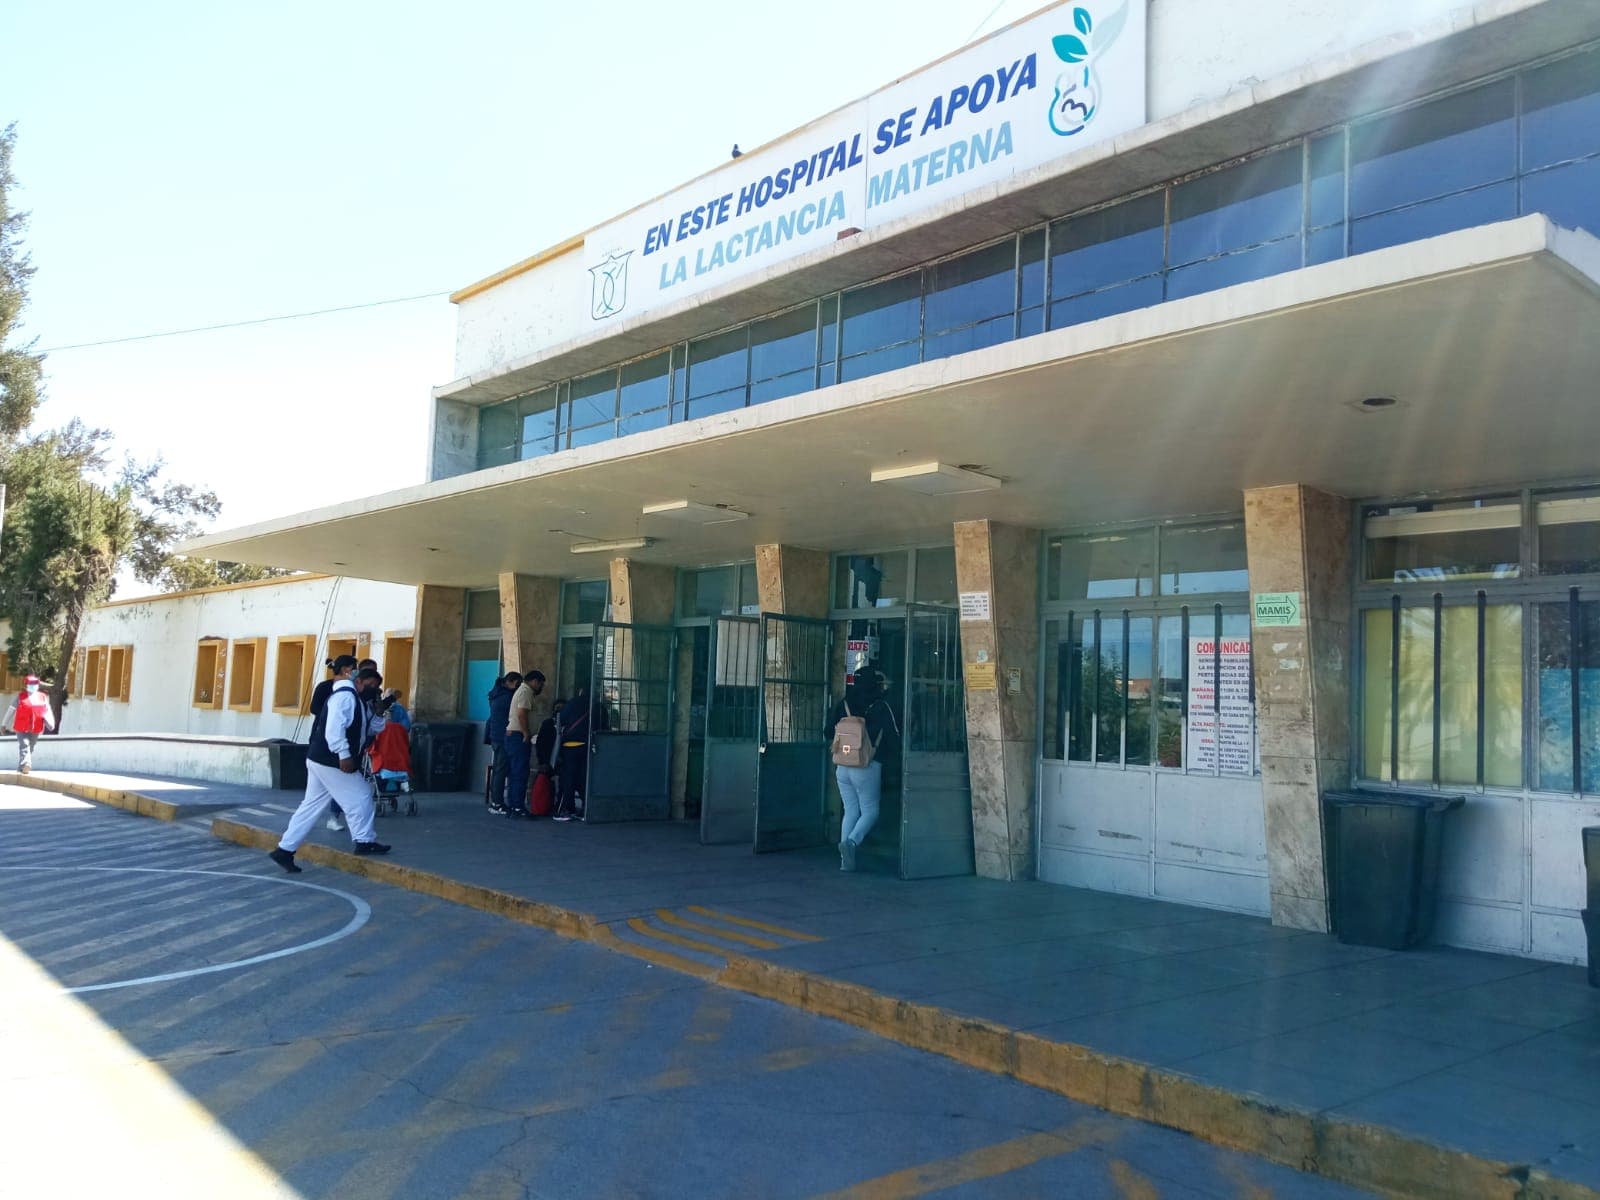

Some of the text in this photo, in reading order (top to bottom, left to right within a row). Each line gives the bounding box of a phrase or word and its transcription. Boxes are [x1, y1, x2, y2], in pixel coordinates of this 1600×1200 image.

[643, 52, 1037, 256] EN ESTE HOSPITAL SE APOYA
[659, 121, 1013, 290] LA LACTANCIA MATERNA
[1258, 606, 1291, 615] MAMIS
